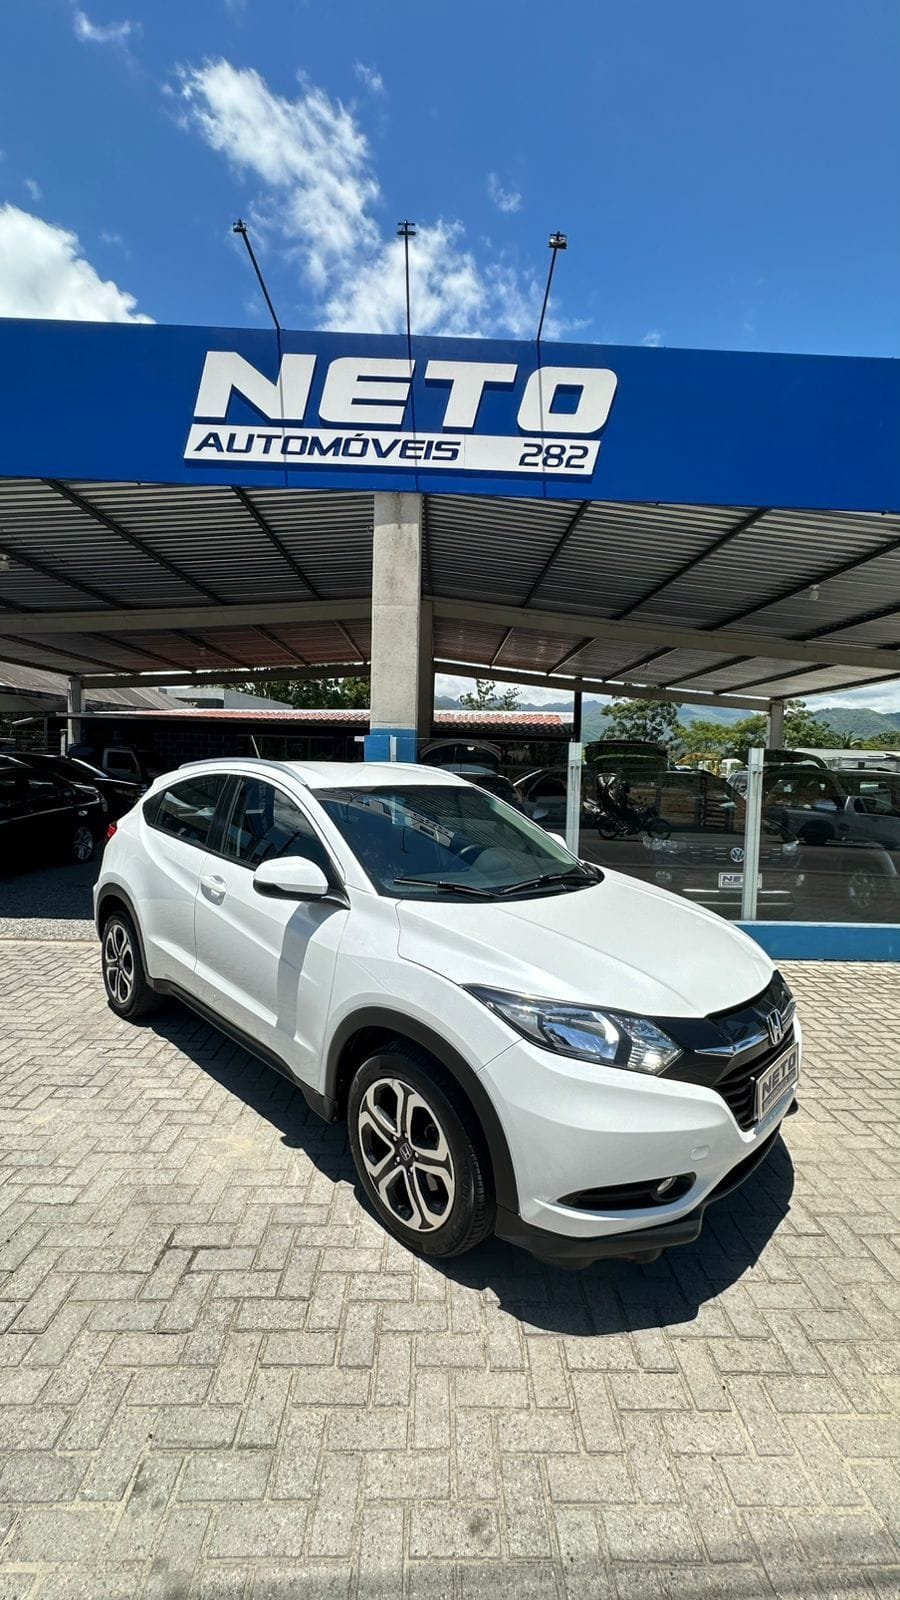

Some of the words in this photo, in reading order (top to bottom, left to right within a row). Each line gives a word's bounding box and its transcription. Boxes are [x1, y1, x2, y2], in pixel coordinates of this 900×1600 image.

[193, 351, 618, 433] NETO
[194, 433, 461, 461] AUTOMÓVEIS
[518, 443, 589, 468] 282
[762, 1051, 796, 1100] NETO
